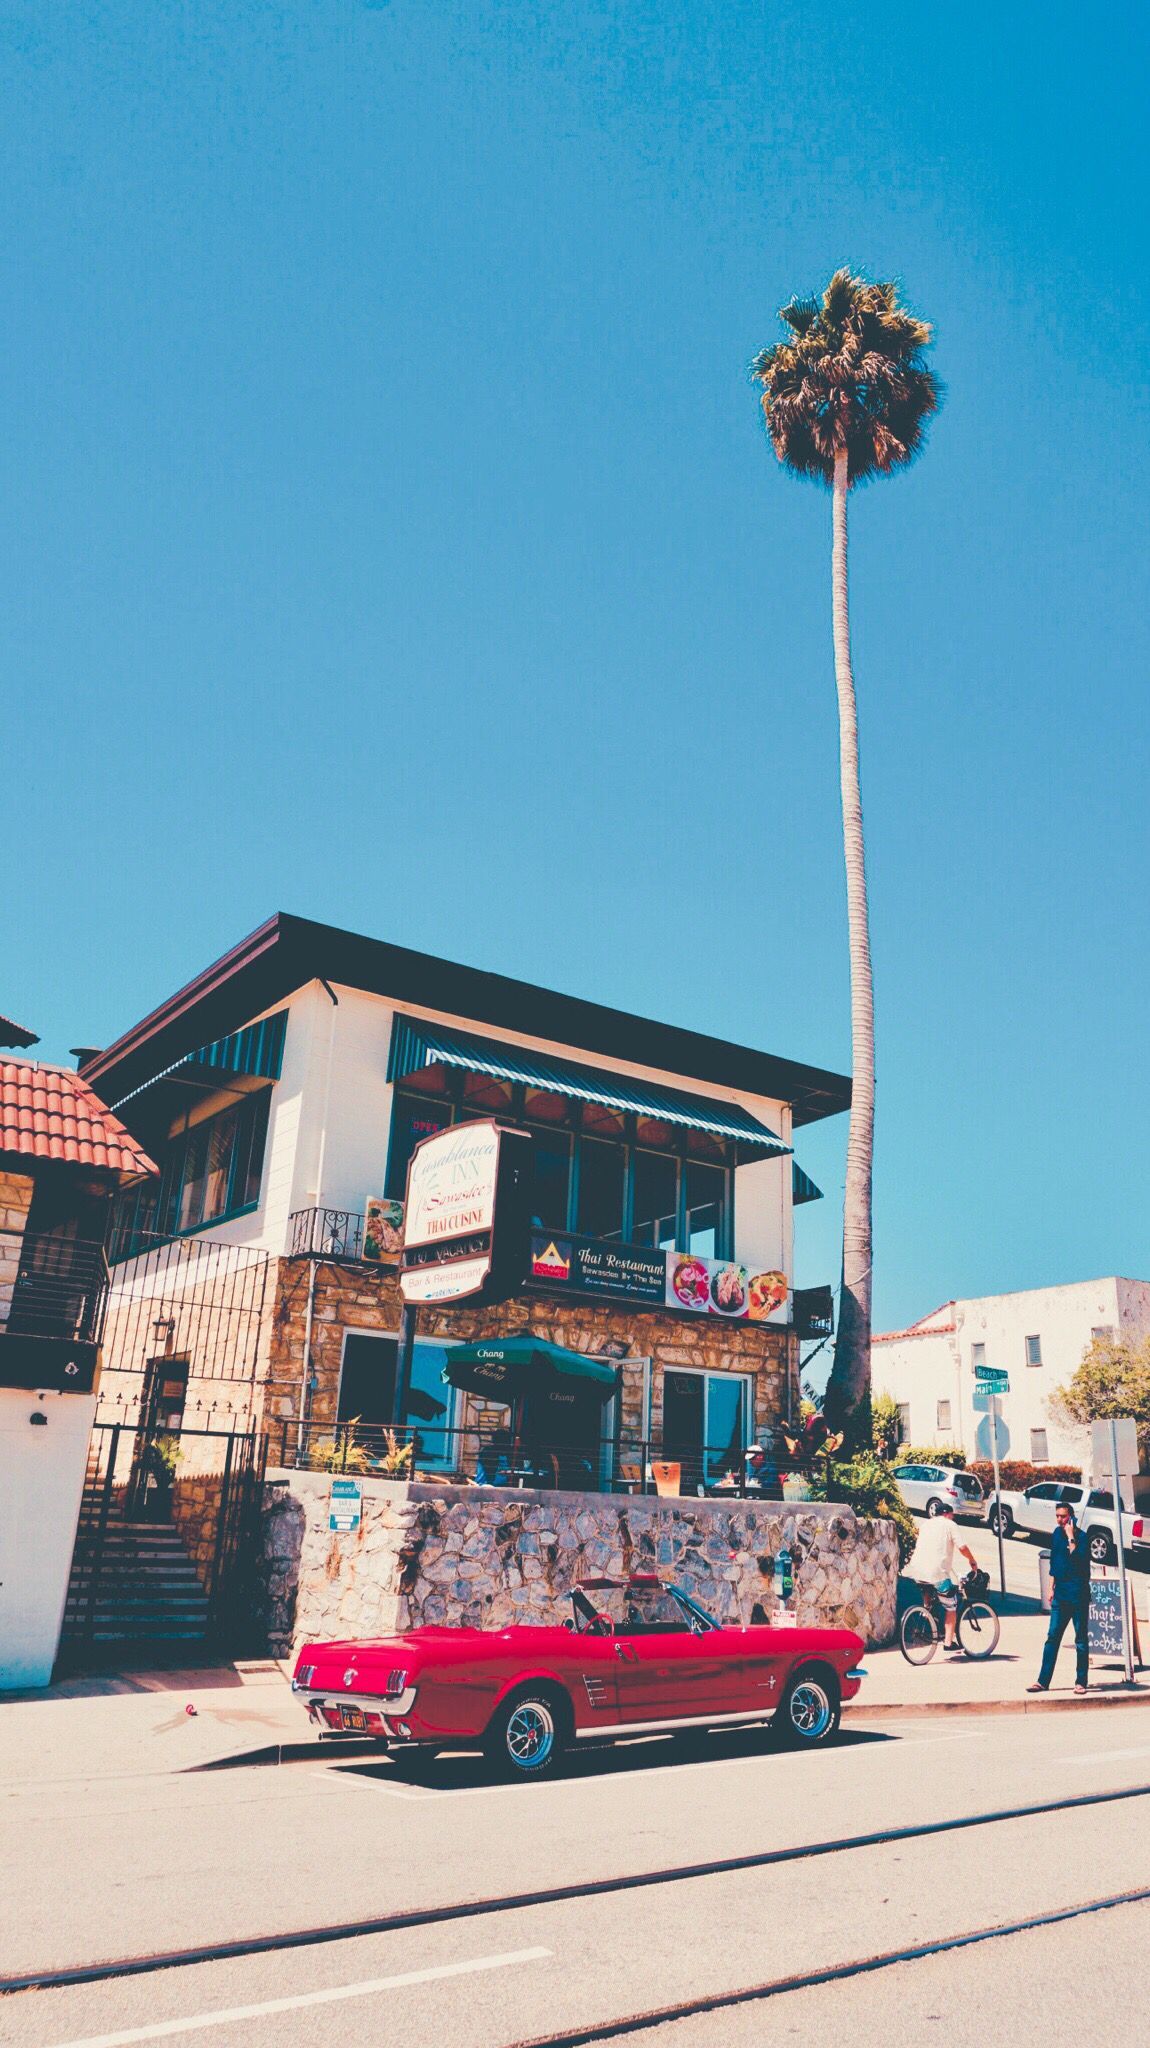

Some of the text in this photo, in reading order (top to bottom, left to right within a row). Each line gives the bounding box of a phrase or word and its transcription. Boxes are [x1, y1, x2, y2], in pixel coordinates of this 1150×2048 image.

[412, 1132, 495, 1182] Casablanca
[453, 1160, 479, 1184] INN
[424, 1183, 486, 1211] Sawasdee
[427, 1209, 483, 1235] THAI CUISINE
[436, 1239, 485, 1261] VACANCY
[578, 1248, 665, 1277] Thai Restaurant
[409, 1267, 482, 1288] Bar & Restaurant
[477, 1348, 504, 1359] Chang
[473, 1366, 506, 1381] Chang
[978, 1368, 997, 1380] Beach
[549, 1392, 576, 1403] Chang
[976, 1383, 992, 1394] Main
[1108, 1581, 1121, 1596] Us
[1095, 1593, 1111, 1604] for
